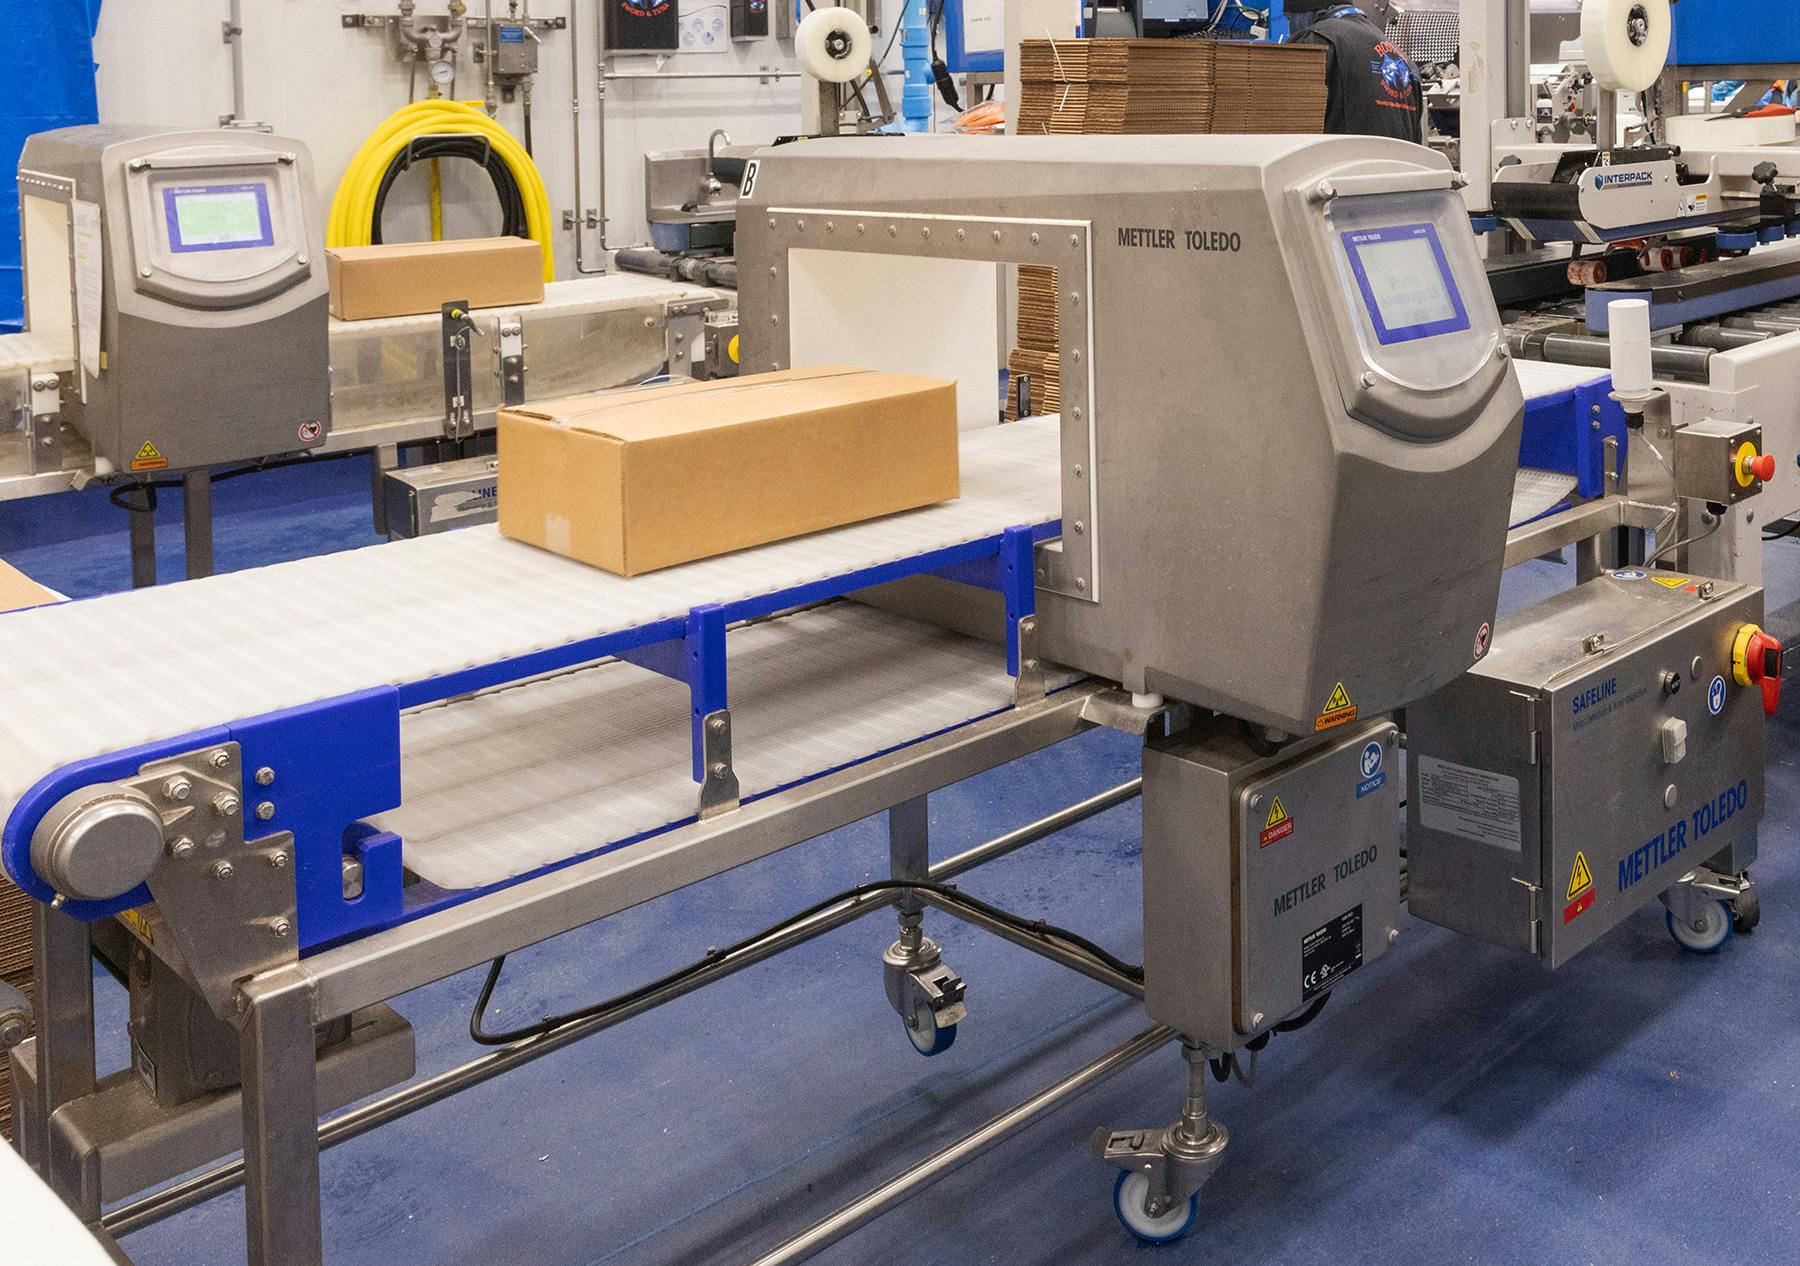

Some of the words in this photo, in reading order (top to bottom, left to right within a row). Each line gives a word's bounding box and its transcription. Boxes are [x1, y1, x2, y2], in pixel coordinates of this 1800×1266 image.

[742, 162, 757, 196] B
[1604, 171, 1653, 184] INTERPACK
[1118, 227, 1176, 249] METTLER
[1184, 230, 1241, 252] TOLEDO
[1572, 677, 1617, 715] SAFELINE
[1323, 709, 1355, 725] WARNING
[1360, 776, 1382, 793] NOTICE
[1268, 822, 1292, 839] DANGER
[1618, 819, 1687, 892] METTLER
[1692, 779, 1747, 841] TOLEDO
[1274, 873, 1326, 917] METTLER
[1333, 844, 1377, 882] TOLEDO
